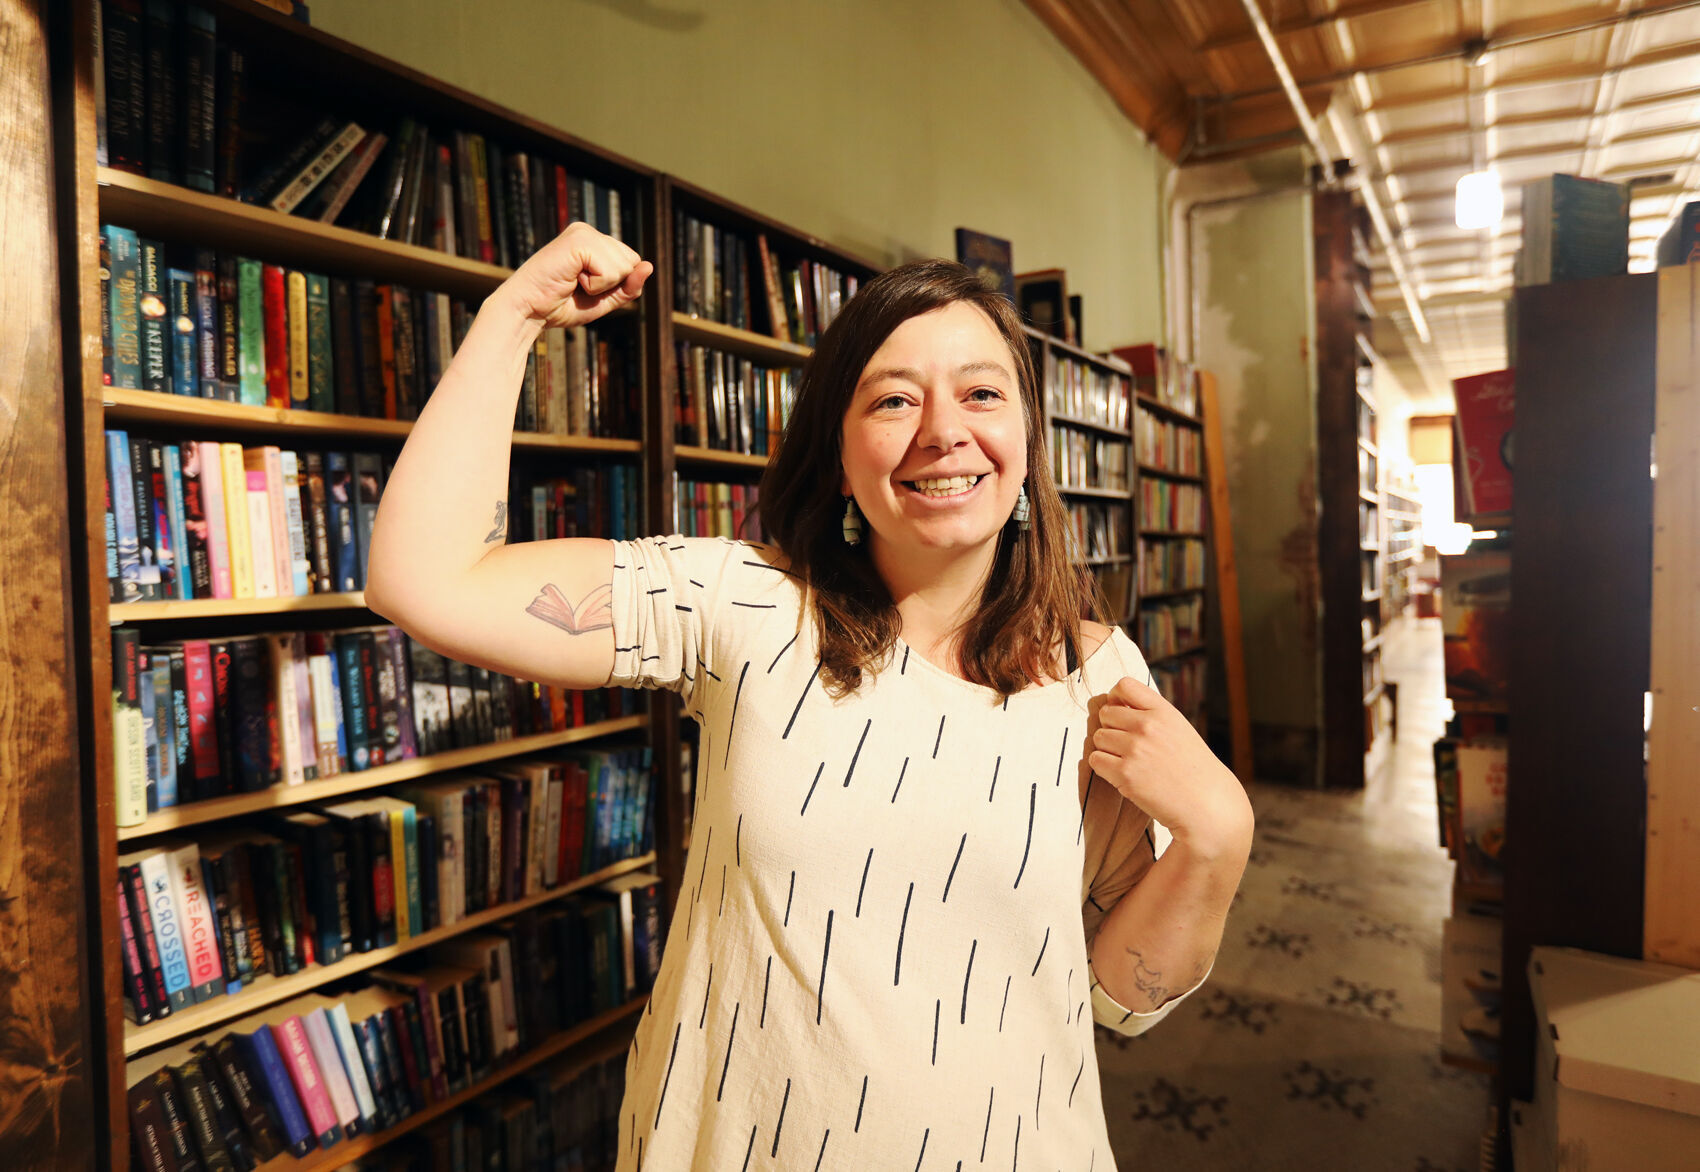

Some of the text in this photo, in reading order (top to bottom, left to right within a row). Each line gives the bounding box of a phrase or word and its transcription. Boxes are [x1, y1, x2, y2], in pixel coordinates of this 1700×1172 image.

[145, 246, 158, 292] BALDACCI
[146, 330, 164, 379] KEEPER
[204, 330, 216, 378] ARISING
[137, 480, 146, 516] FROZEN
[126, 642, 134, 659] LOST
[128, 660, 136, 675] AND
[128, 716, 142, 802] ORSON SCOTT CARD
